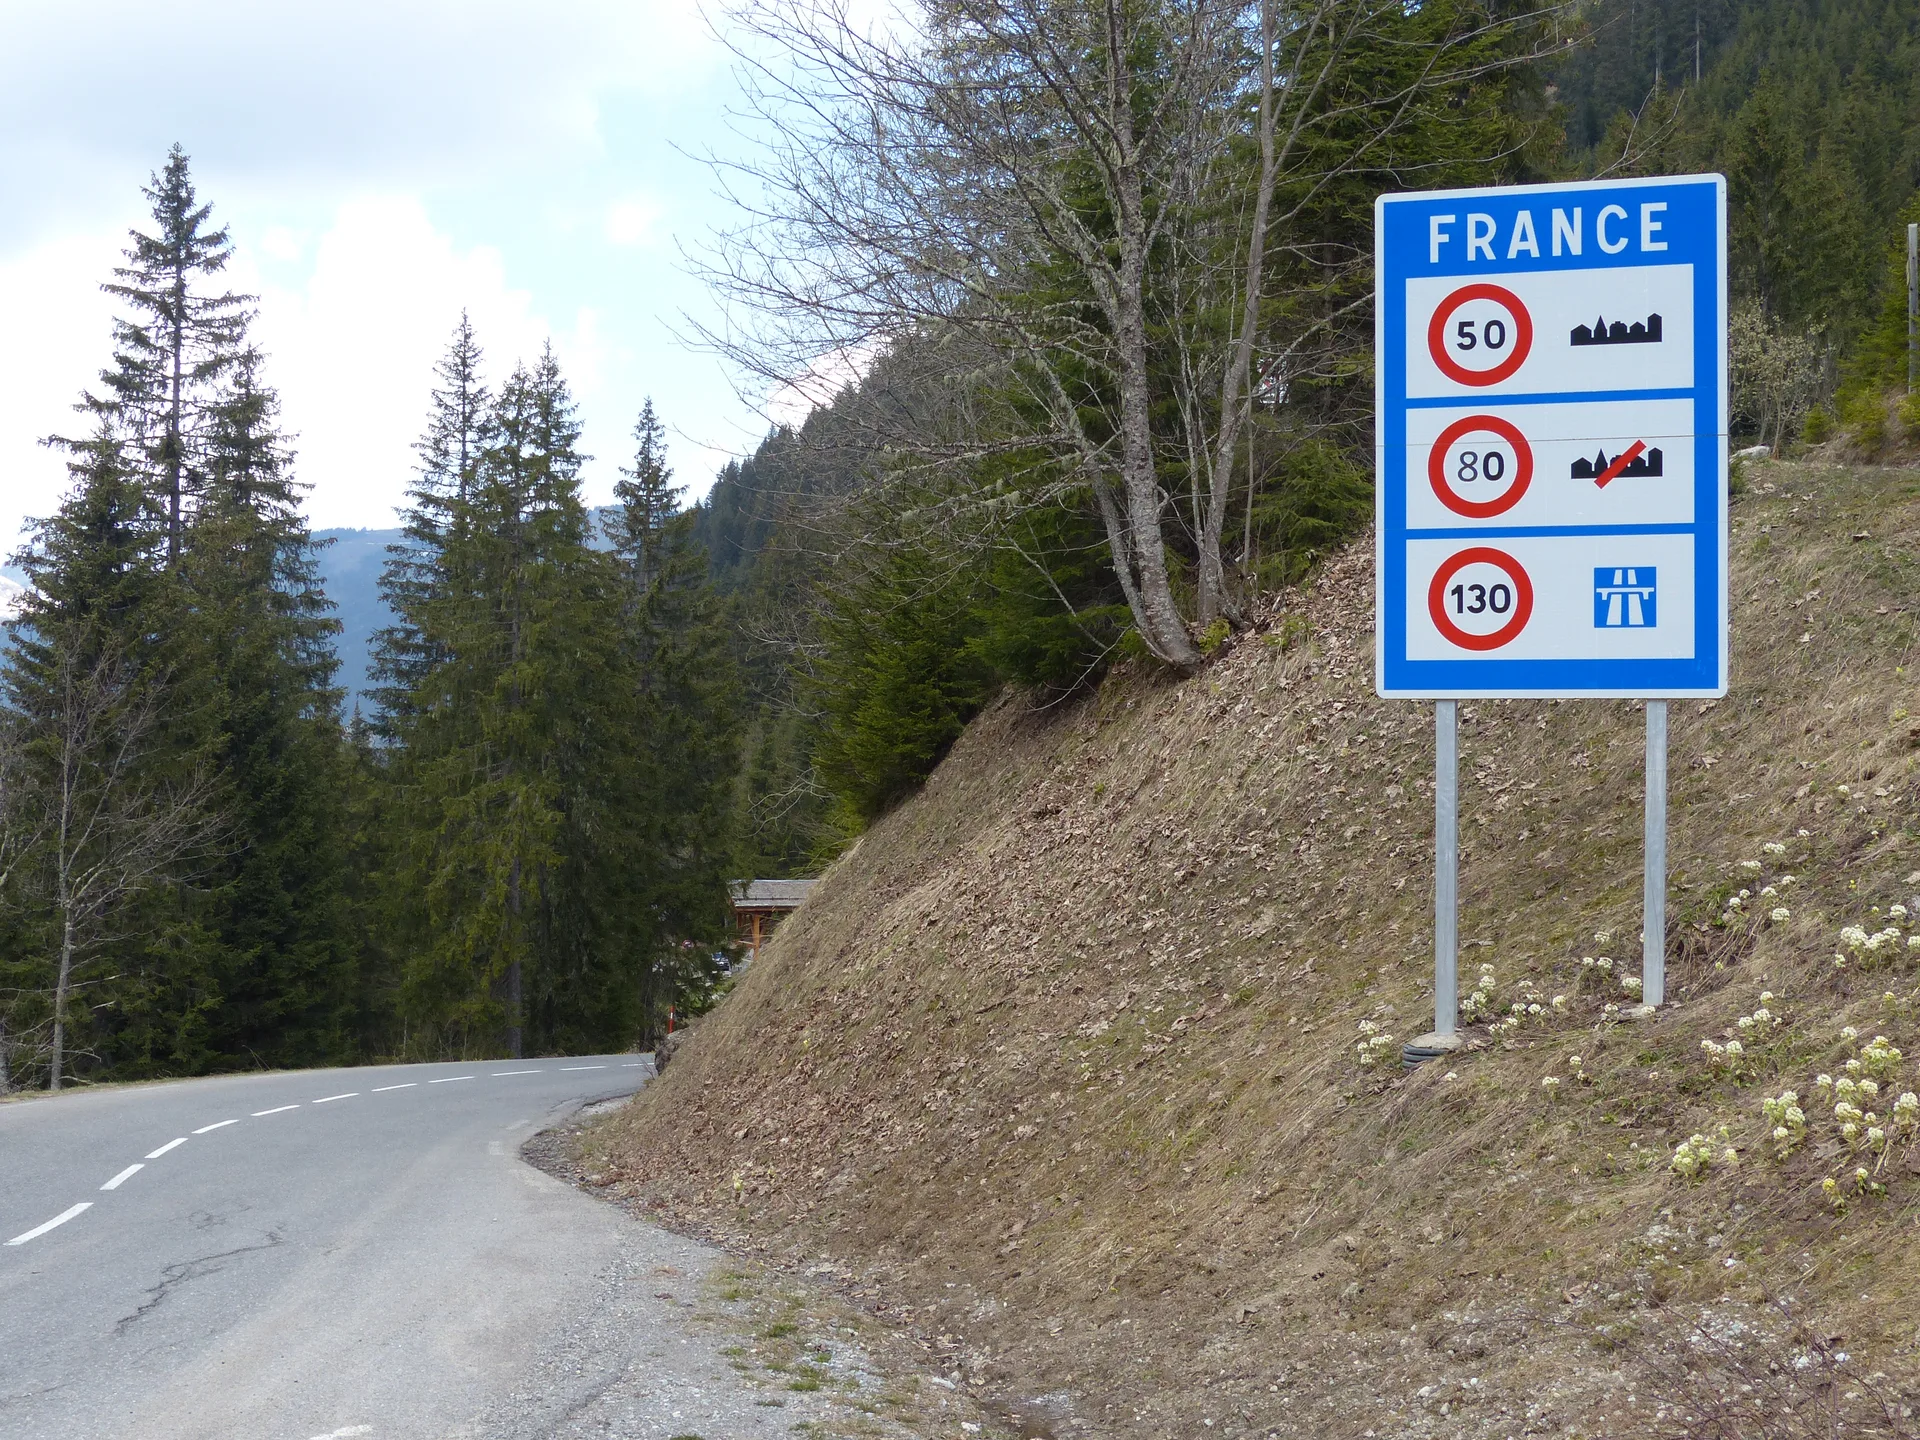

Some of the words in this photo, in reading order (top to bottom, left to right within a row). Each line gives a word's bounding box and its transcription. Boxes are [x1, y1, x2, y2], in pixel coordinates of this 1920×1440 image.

[1429, 202, 1668, 263] FRANCE
[1456, 319, 1506, 350] 50
[1457, 451, 1505, 482] 80
[1450, 583, 1511, 614] 130
